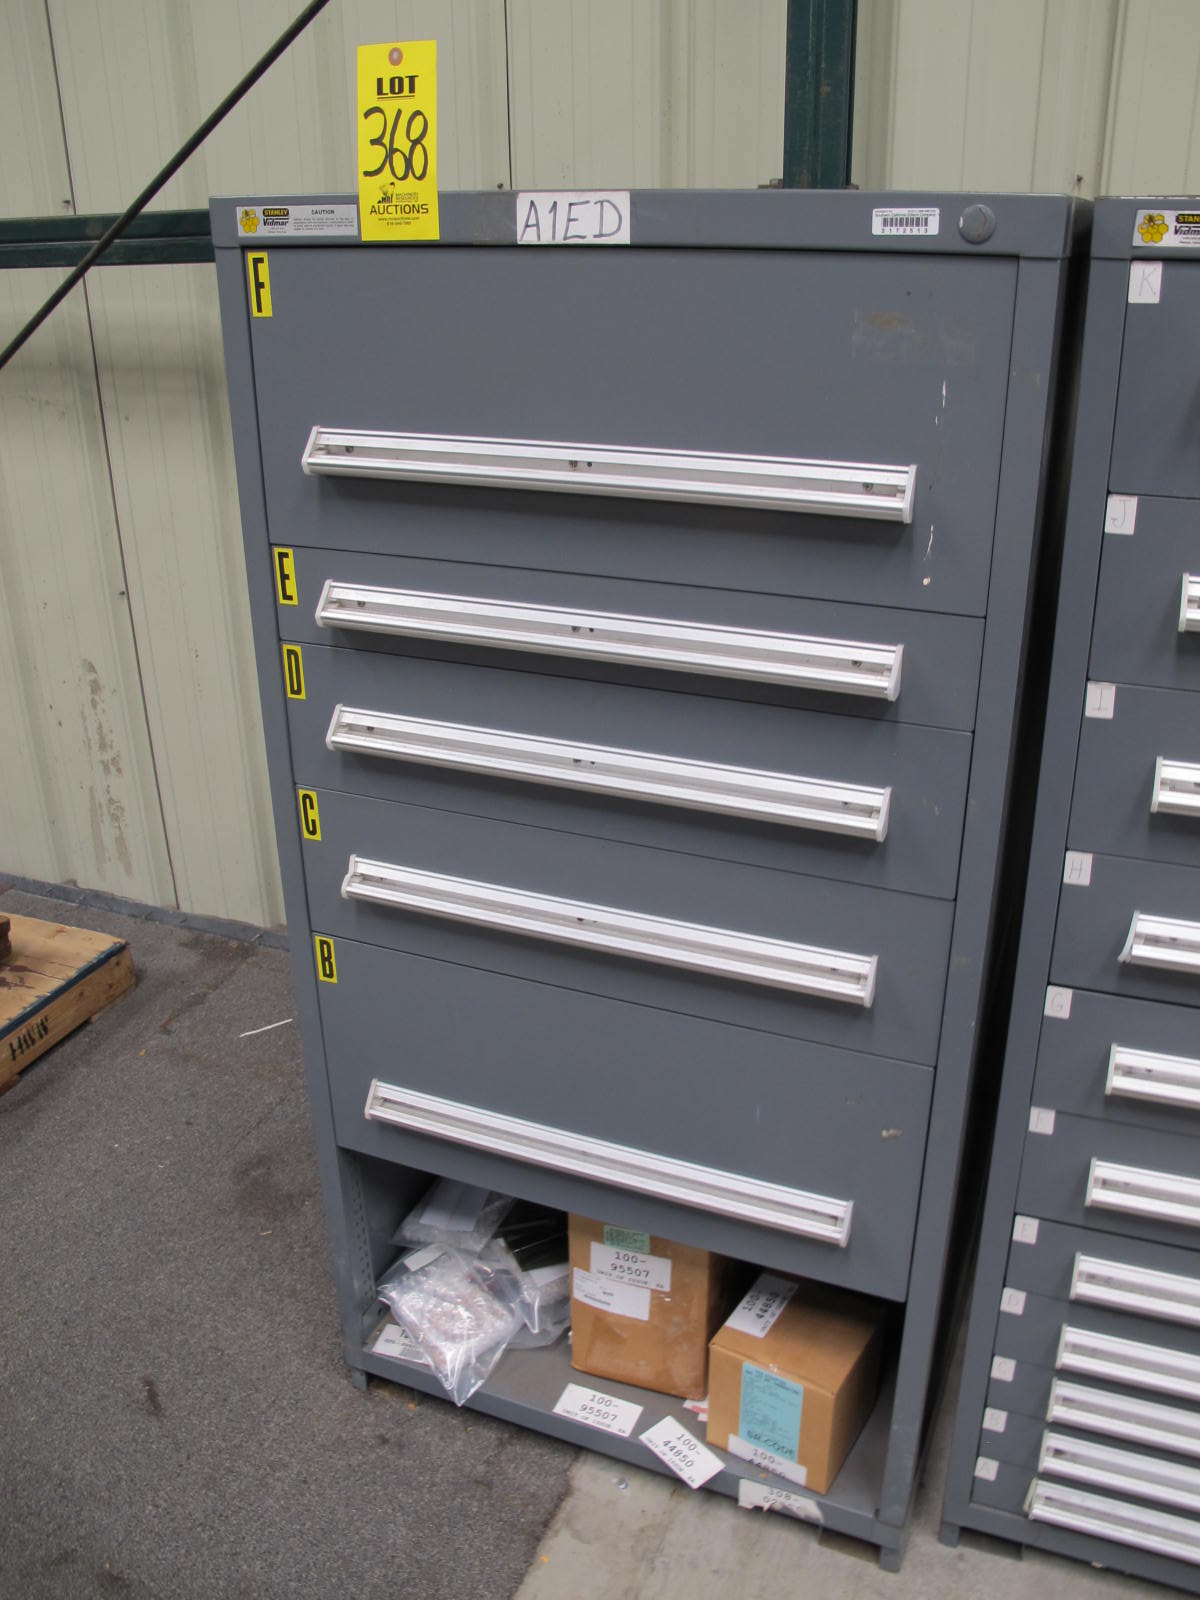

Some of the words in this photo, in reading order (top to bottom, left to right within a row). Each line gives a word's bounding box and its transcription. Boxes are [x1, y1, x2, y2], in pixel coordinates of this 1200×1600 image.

[376, 74, 419, 96] LOT
[363, 105, 429, 181] 368
[263, 208, 288, 216] STANLEY
[370, 204, 429, 215] AUCTIONS
[519, 199, 623, 241] A1ED
[263, 218, 289, 226] Vidmar
[252, 257, 265, 313] F
[1138, 267, 1157, 298] K
[1111, 499, 1131, 529] J
[277, 552, 293, 600] E
[286, 649, 302, 695] D
[302, 793, 316, 835] C
[1068, 858, 1084, 881] H
[319, 940, 333, 979] B
[615, 1251, 647, 1264] 100-
[610, 1263, 650, 1278] 95507
[589, 1394, 619, 1408] 100-
[580, 1404, 618, 1422] 95507
[662, 1440, 695, 1468] 44850
[676, 1433, 701, 1456] 100-
[753, 1448, 782, 1465] 100-
